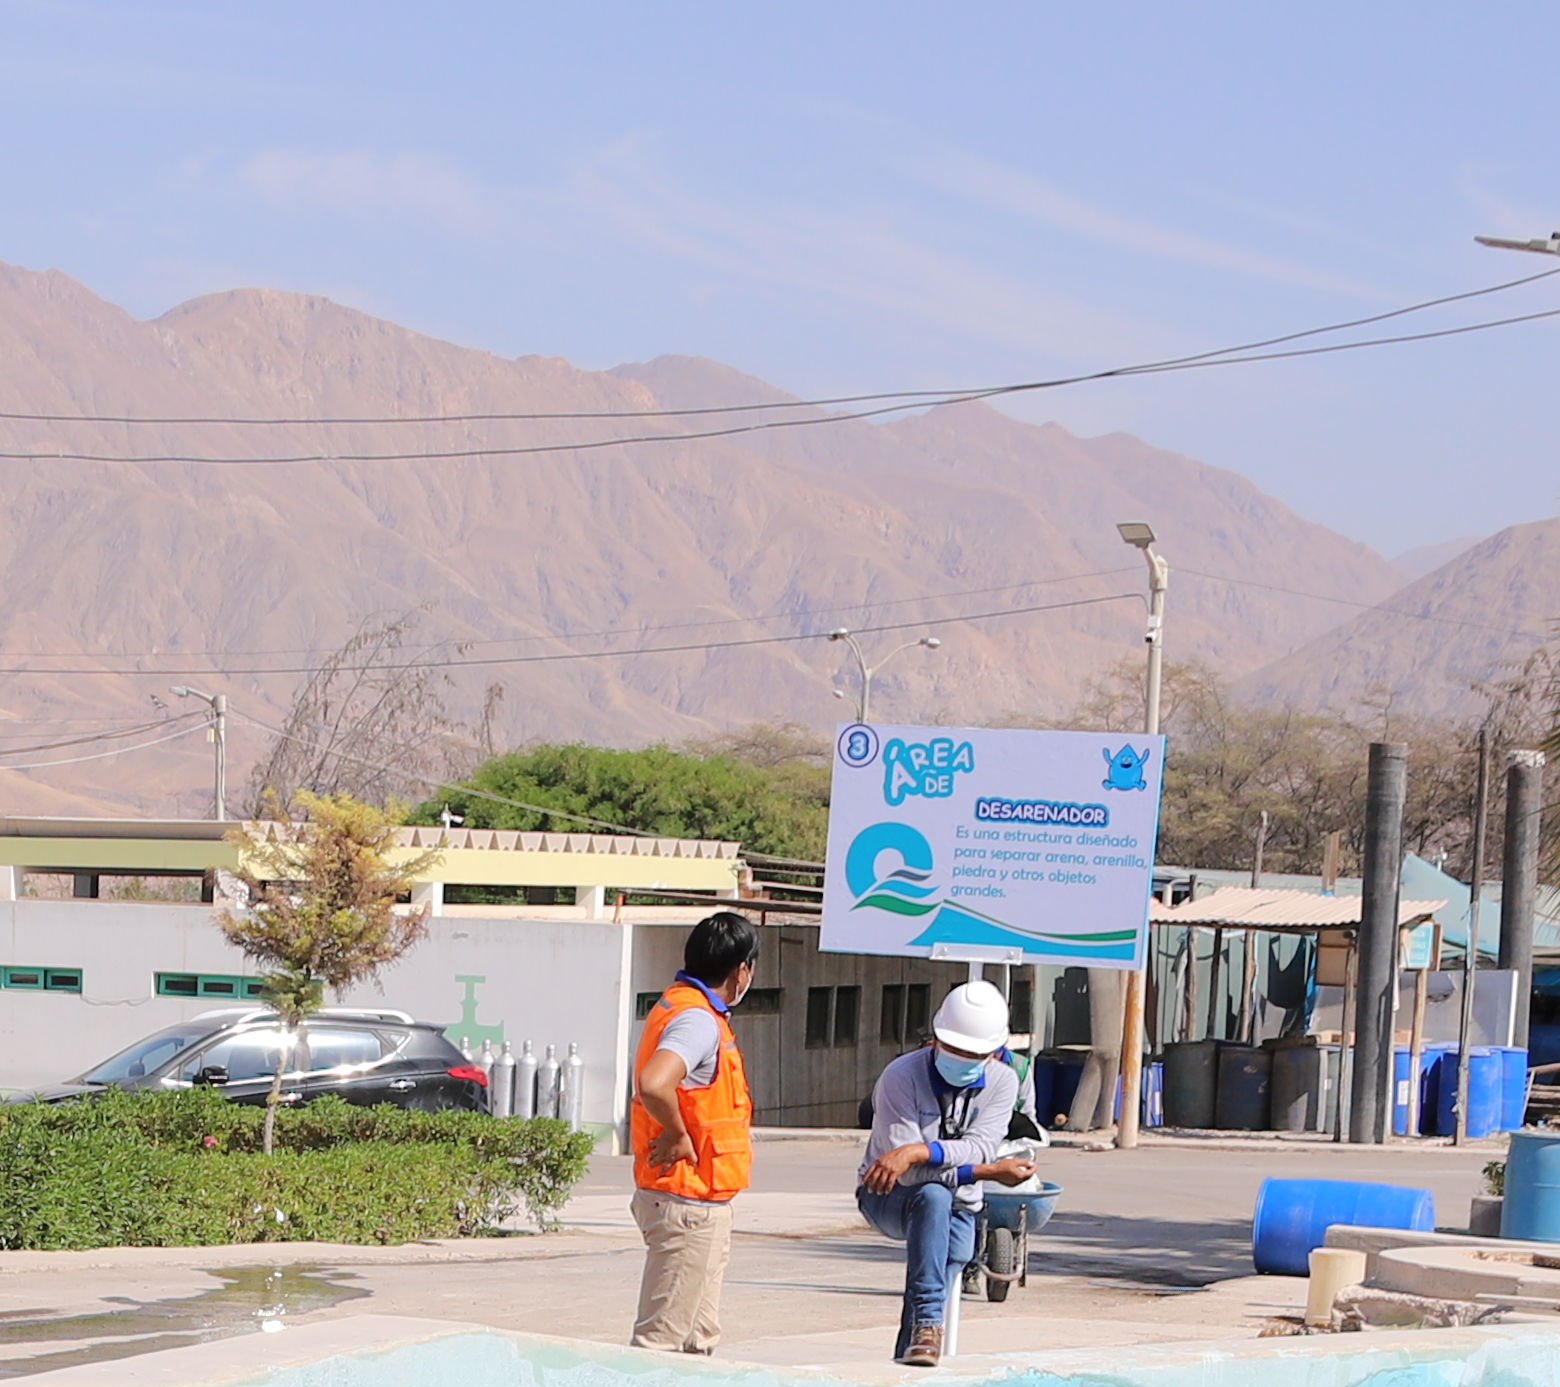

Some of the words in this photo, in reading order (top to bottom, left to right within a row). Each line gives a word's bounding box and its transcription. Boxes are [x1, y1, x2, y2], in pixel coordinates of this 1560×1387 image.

[849, 733, 867, 758] 3
[924, 775, 950, 794] DE
[978, 801, 1106, 824] DESARENADOR
[955, 825, 969, 839] Es
[973, 829, 1000, 841] una
[1003, 829, 1072, 845] estructura
[1076, 832, 1138, 848] diseñado
[954, 847, 986, 860] para
[990, 849, 1041, 863] separar
[1045, 852, 1089, 866] arena,
[1092, 854, 1148, 870] arenilla,
[952, 864, 996, 878] piedra
[999, 869, 1008, 881] y
[1011, 868, 1044, 882] otros
[1048, 869, 1096, 885] objetos
[950, 884, 1007, 899] grandes.
